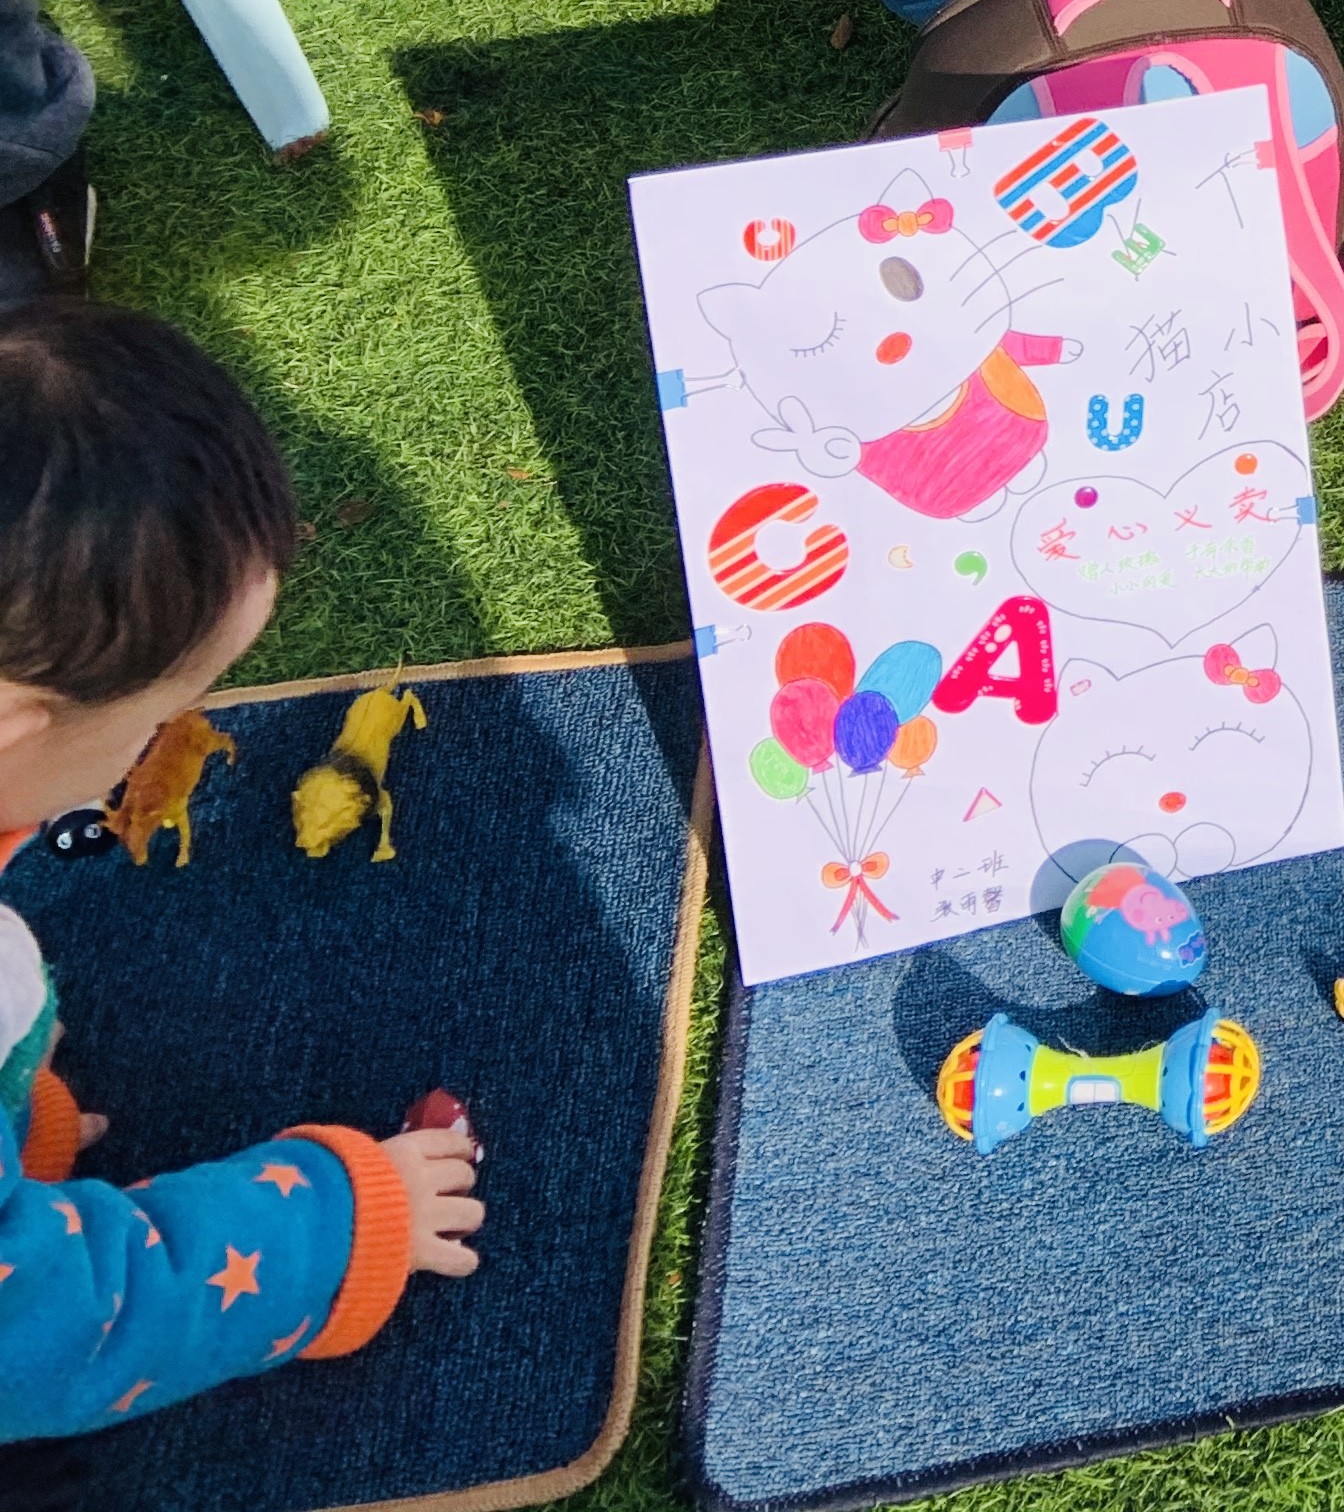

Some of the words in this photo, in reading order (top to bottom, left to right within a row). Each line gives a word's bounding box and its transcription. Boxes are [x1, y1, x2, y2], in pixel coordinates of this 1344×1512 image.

[1086, 393, 1145, 452] U
[1036, 486, 1277, 562] 爱心义卖
[932, 595, 1058, 726] A
